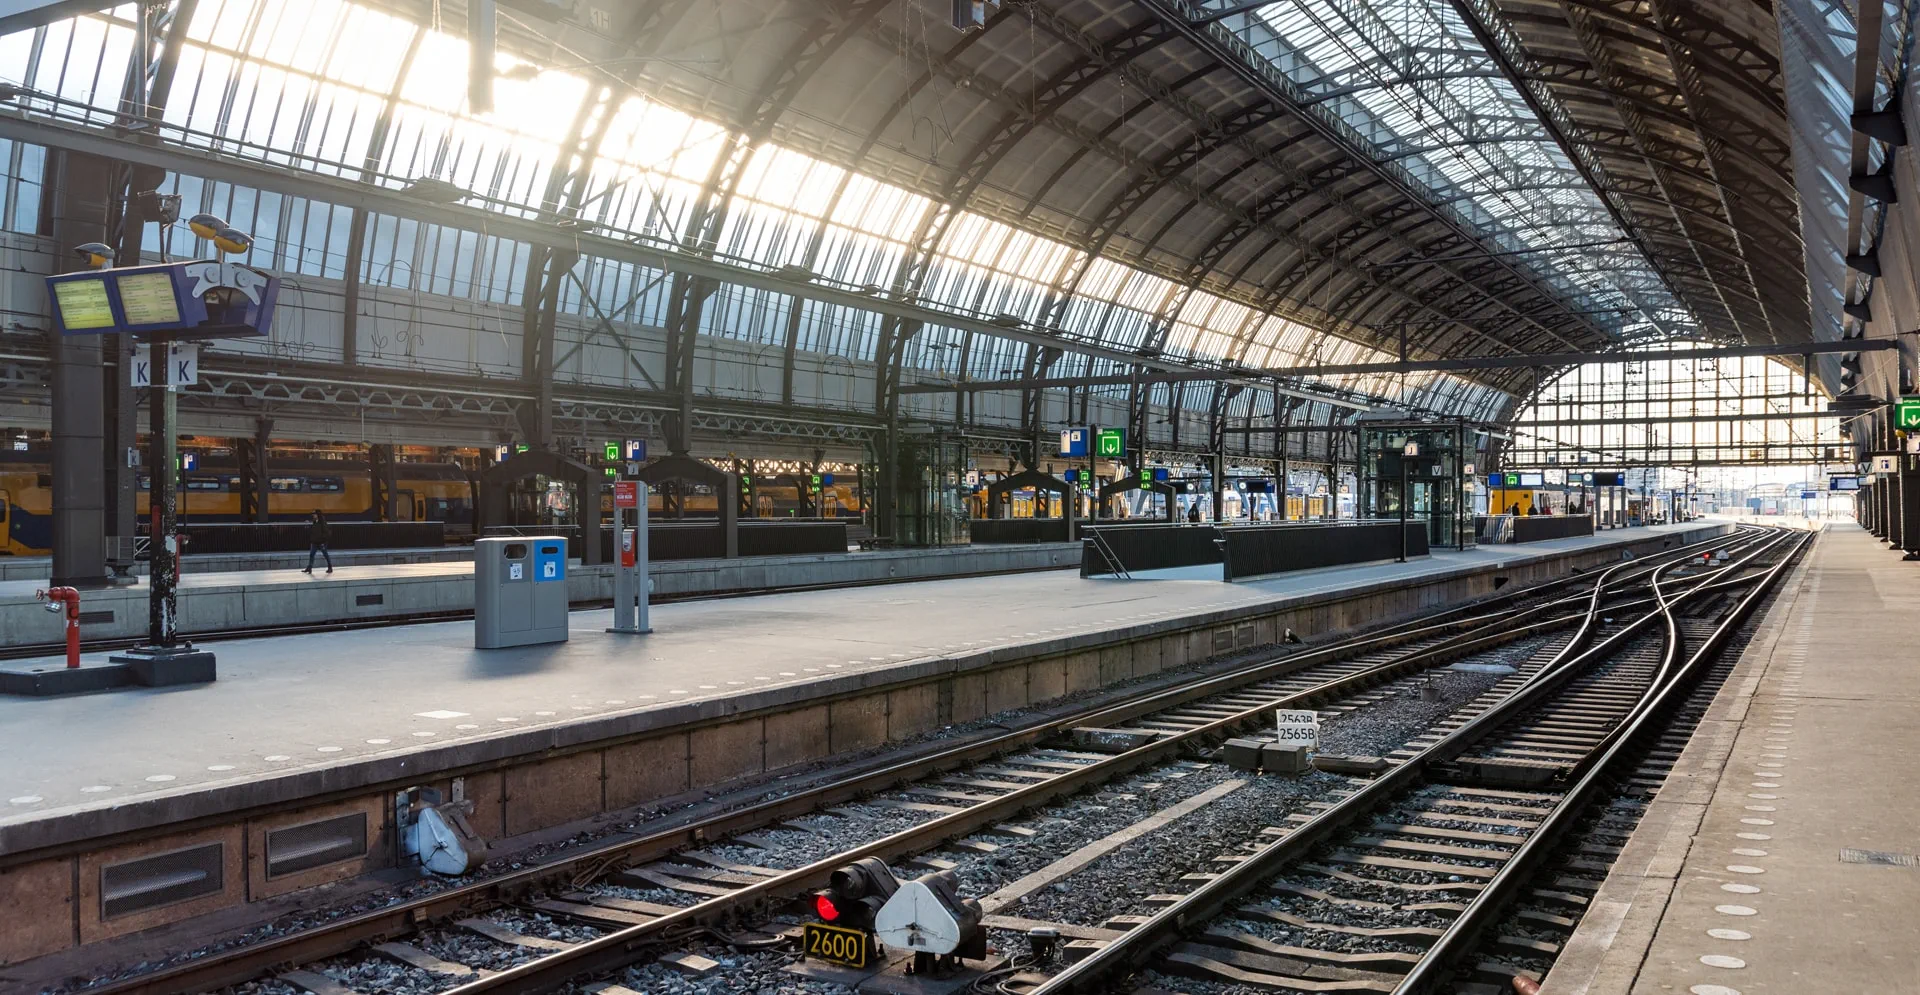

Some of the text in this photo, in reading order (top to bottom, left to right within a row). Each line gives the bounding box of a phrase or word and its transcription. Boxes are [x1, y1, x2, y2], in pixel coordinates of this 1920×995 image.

[137, 362, 148, 383] K
[179, 360, 190, 382] K
[1408, 446, 1413, 454] J
[1432, 466, 1441, 475] V
[1861, 463, 1871, 474] V
[1281, 714, 1313, 723] 2563B
[1280, 728, 1315, 740] 2565B
[811, 929, 858, 960] 2600
